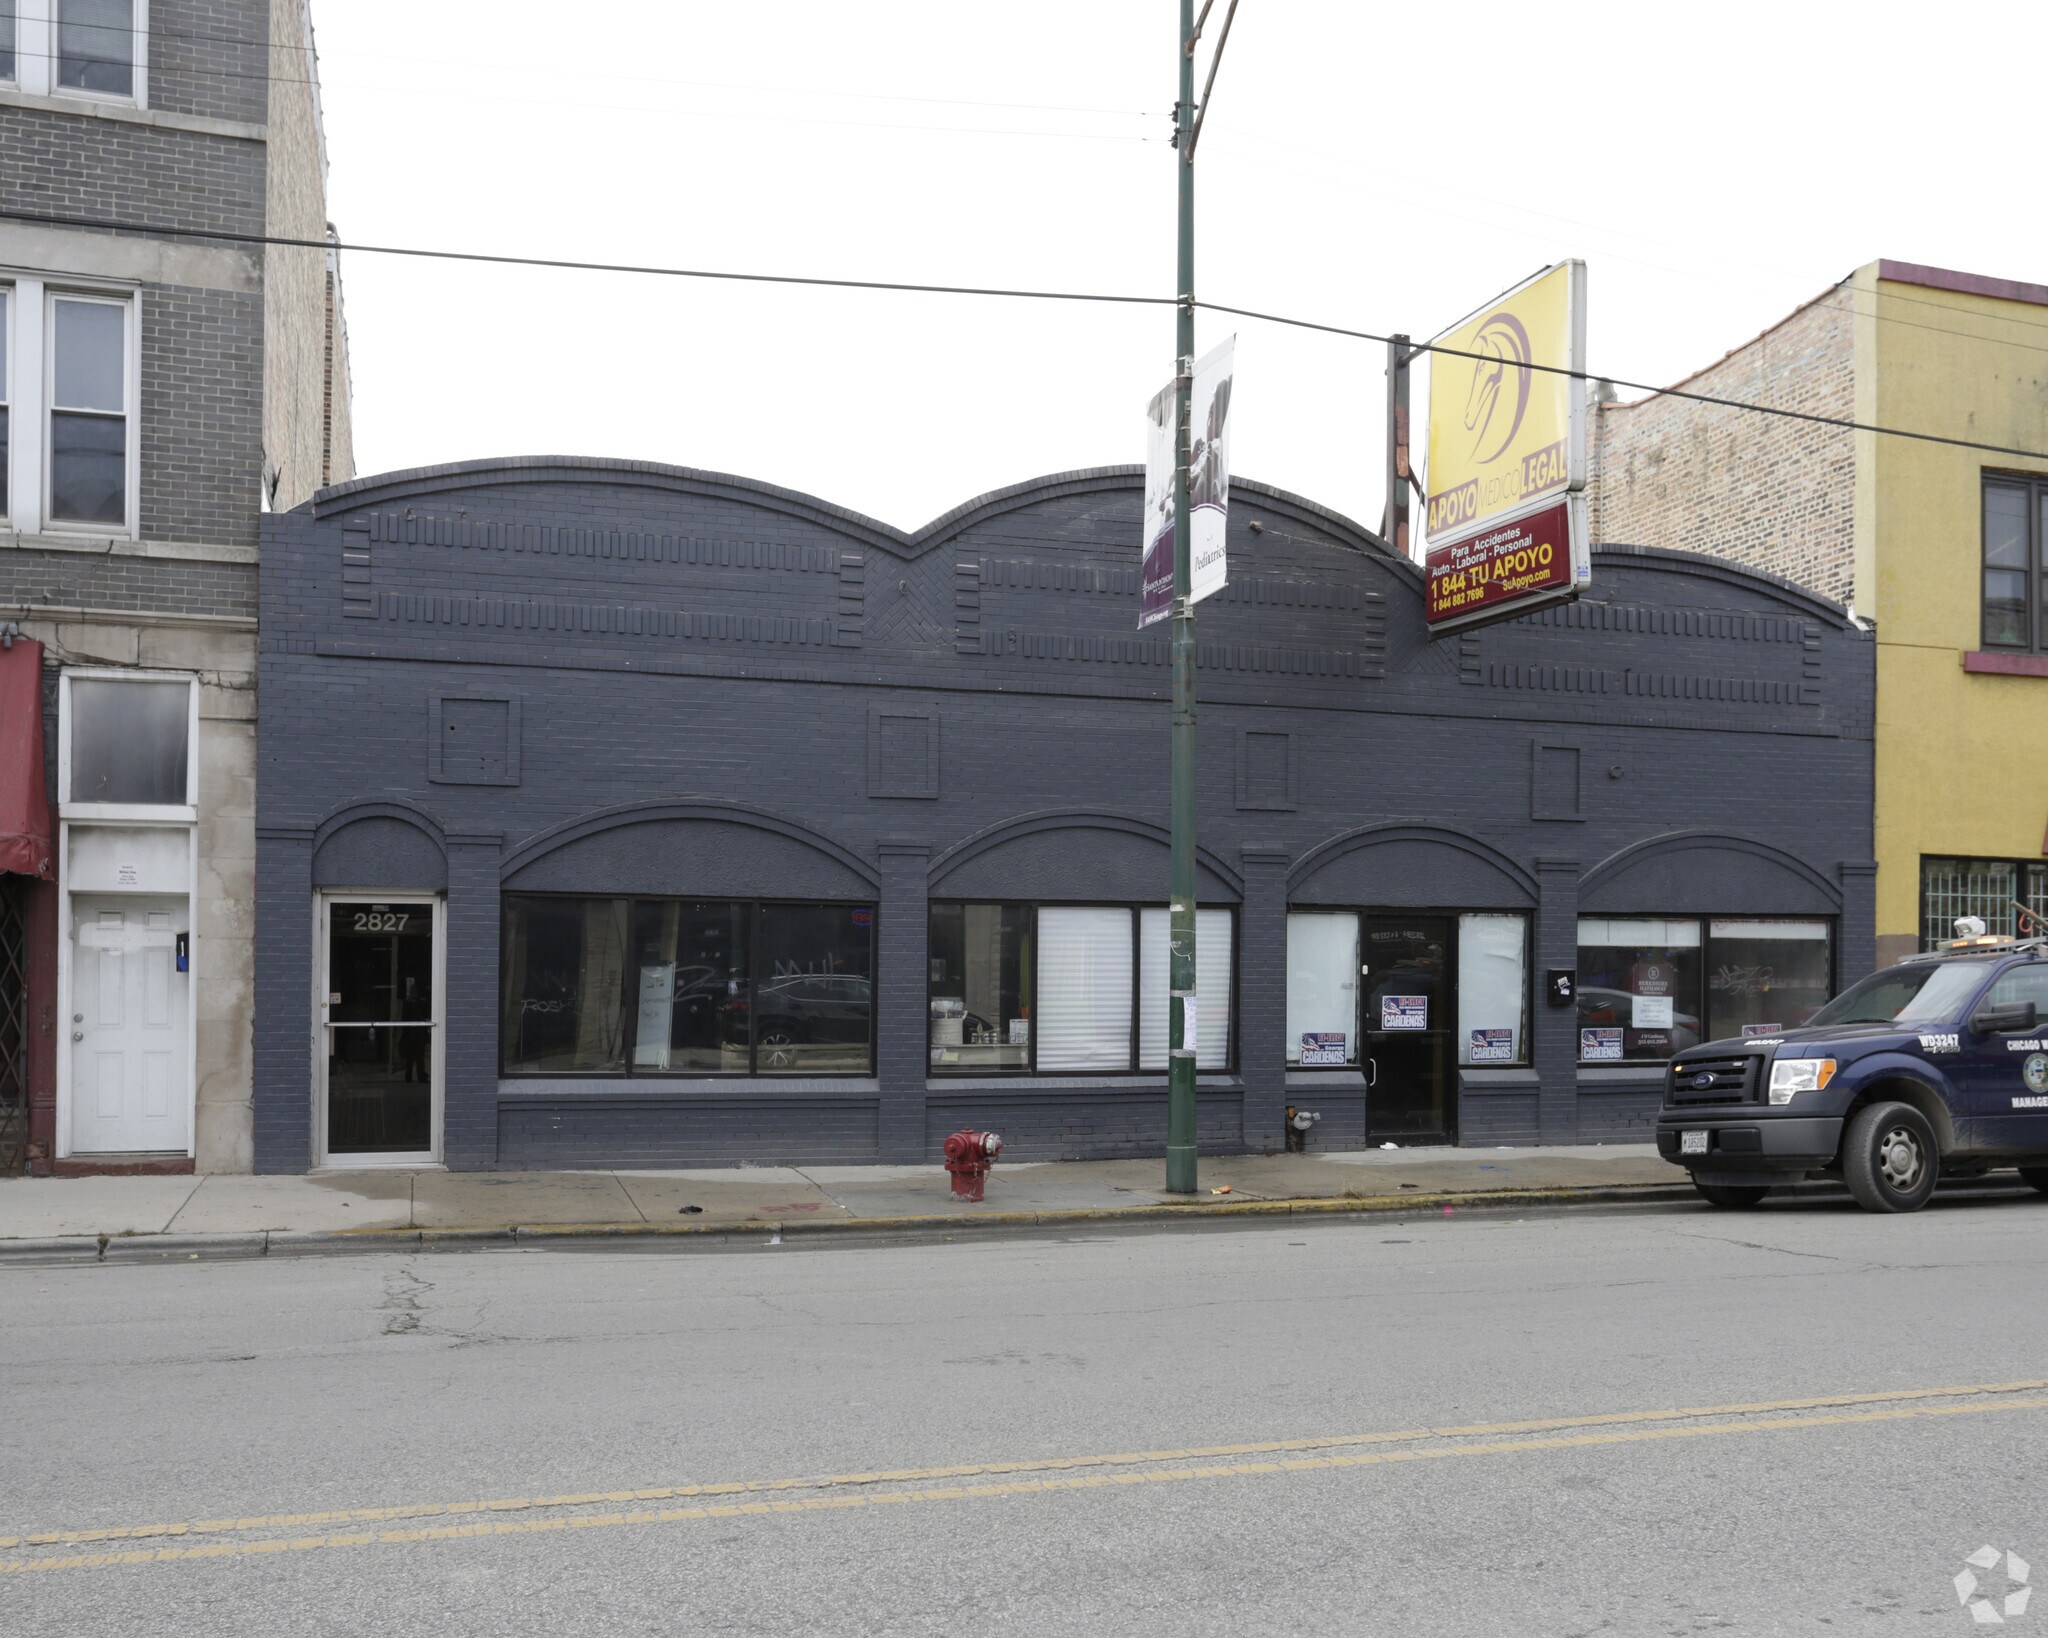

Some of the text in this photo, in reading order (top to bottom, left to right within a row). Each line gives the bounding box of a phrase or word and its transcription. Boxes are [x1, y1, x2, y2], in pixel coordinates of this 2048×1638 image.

[1428, 483, 1477, 532] APOYO
[1520, 445, 1567, 495] LEGAL
[1451, 527, 1520, 559] Para Accidentes
[1195, 545, 1226, 572] Pediatrics
[1432, 565, 1450, 577] Auto
[1456, 552, 1487, 570] Laboral
[1493, 533, 1532, 556] Personal
[1431, 580, 1438, 599] 1
[1442, 571, 1466, 595] 844
[1469, 562, 1490, 587] TU
[1493, 543, 1553, 580] APOYO
[1502, 568, 1551, 592] SuApoyo.com
[1433, 604, 1438, 612] 1
[1438, 599, 1451, 610] 844
[1467, 586, 1484, 601] 7696
[353, 912, 410, 931] 2827
[1384, 1014, 1424, 1028] CARDENAS
[1918, 1034, 1959, 1047] WD3247
[2007, 1039, 2040, 1051] CHICAGO
[1302, 1050, 1345, 1064] CARDENAS
[1472, 1046, 1511, 1059] CARDENAS
[1583, 1046, 1621, 1059] CARDENAS
